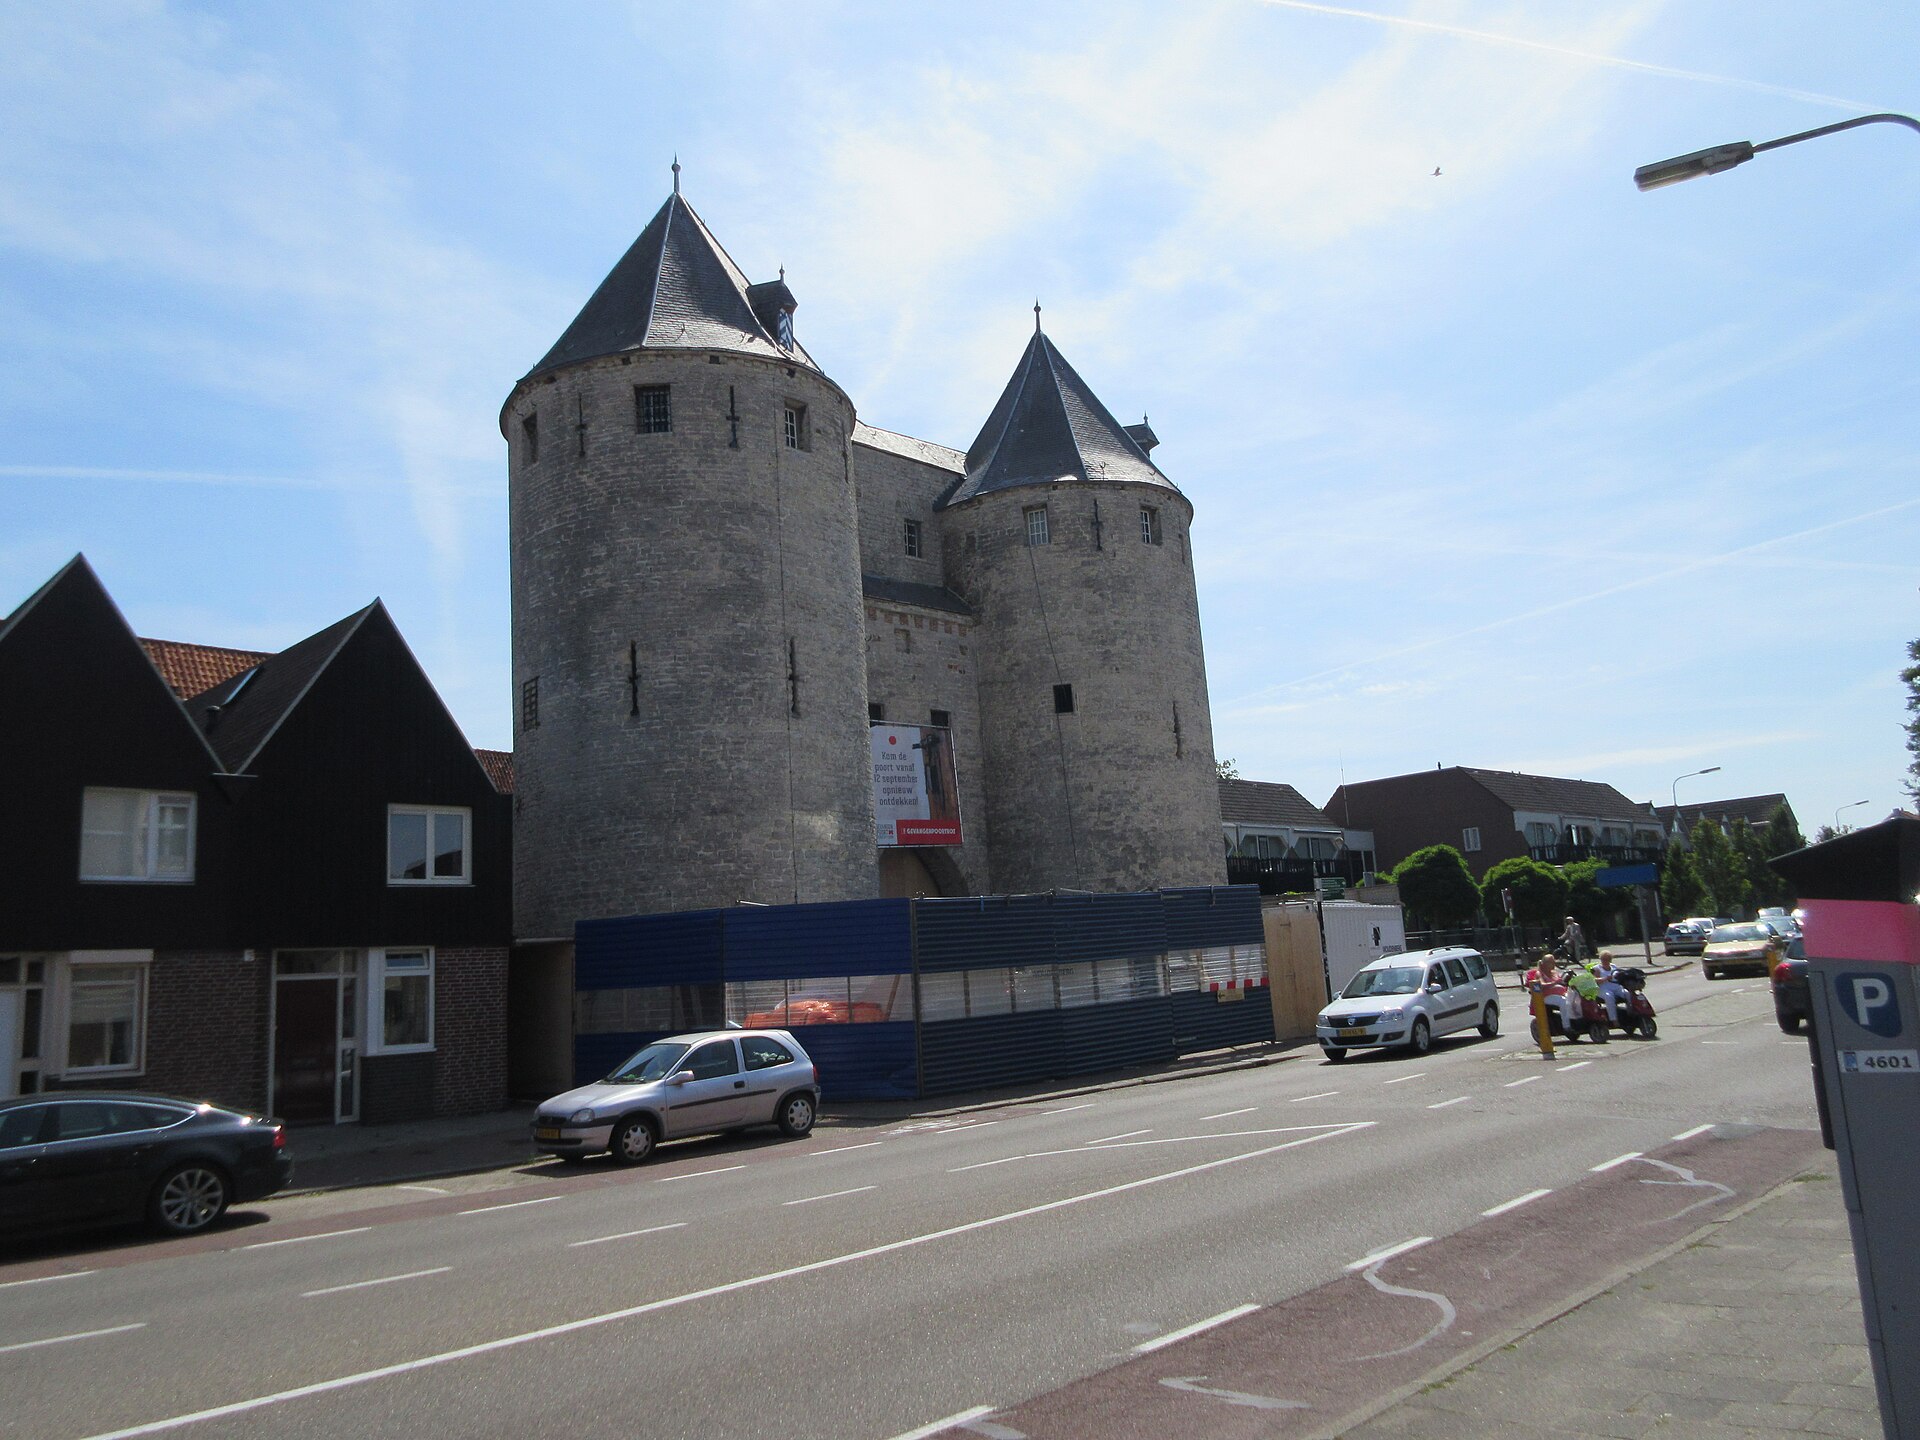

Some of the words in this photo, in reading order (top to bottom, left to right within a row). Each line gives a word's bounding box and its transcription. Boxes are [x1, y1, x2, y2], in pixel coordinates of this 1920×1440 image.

[882, 751, 897, 760] Kom
[898, 751, 906, 760] de
[874, 763, 893, 773] poort
[896, 763, 915, 772] vanaf
[874, 774, 881, 783] 12
[882, 774, 918, 784] september
[882, 787, 913, 796] opnieuw
[1852, 978, 1889, 1025] P
[1865, 1055, 1912, 1068] 4601
